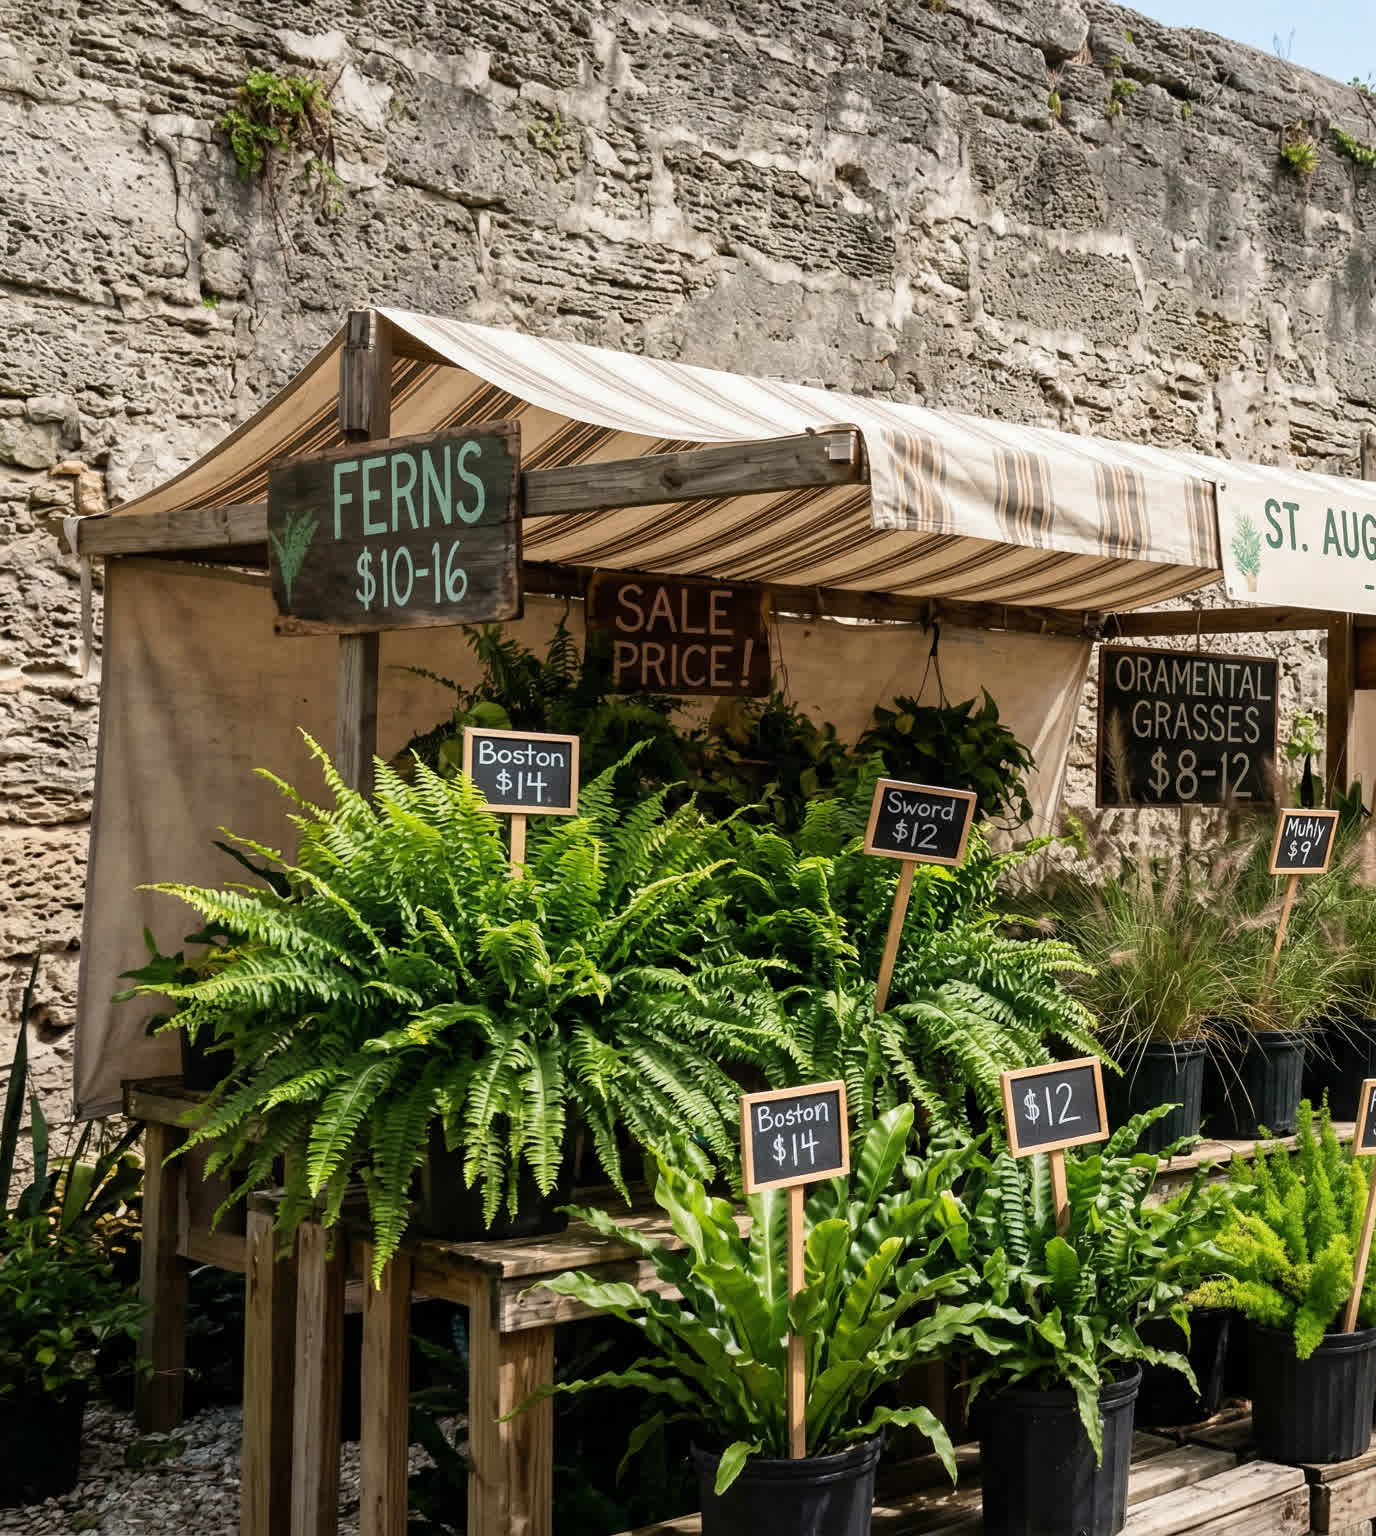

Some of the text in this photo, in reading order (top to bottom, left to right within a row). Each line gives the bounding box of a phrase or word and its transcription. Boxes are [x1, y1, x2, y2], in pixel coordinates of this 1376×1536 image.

[333, 440, 486, 541] FERNS
[1264, 498, 1309, 552] ST.
[355, 539, 468, 611] $10-16
[615, 583, 734, 636] SALE
[612, 636, 754, 688] PRICE!
[1115, 656, 1272, 701] ORAMENTAL
[1132, 700, 1260, 744] GRASSES
[478, 740, 565, 767] Boston
[1148, 746, 1253, 800] $8-12
[495, 767, 548, 803] $14
[887, 791, 956, 821] Sword
[891, 817, 938, 850] $12
[1285, 817, 1326, 846] Muhly
[1287, 840, 1312, 865] $9
[757, 1102, 829, 1132] Boston
[1023, 1082, 1081, 1127] $12
[772, 1129, 820, 1166] $14
